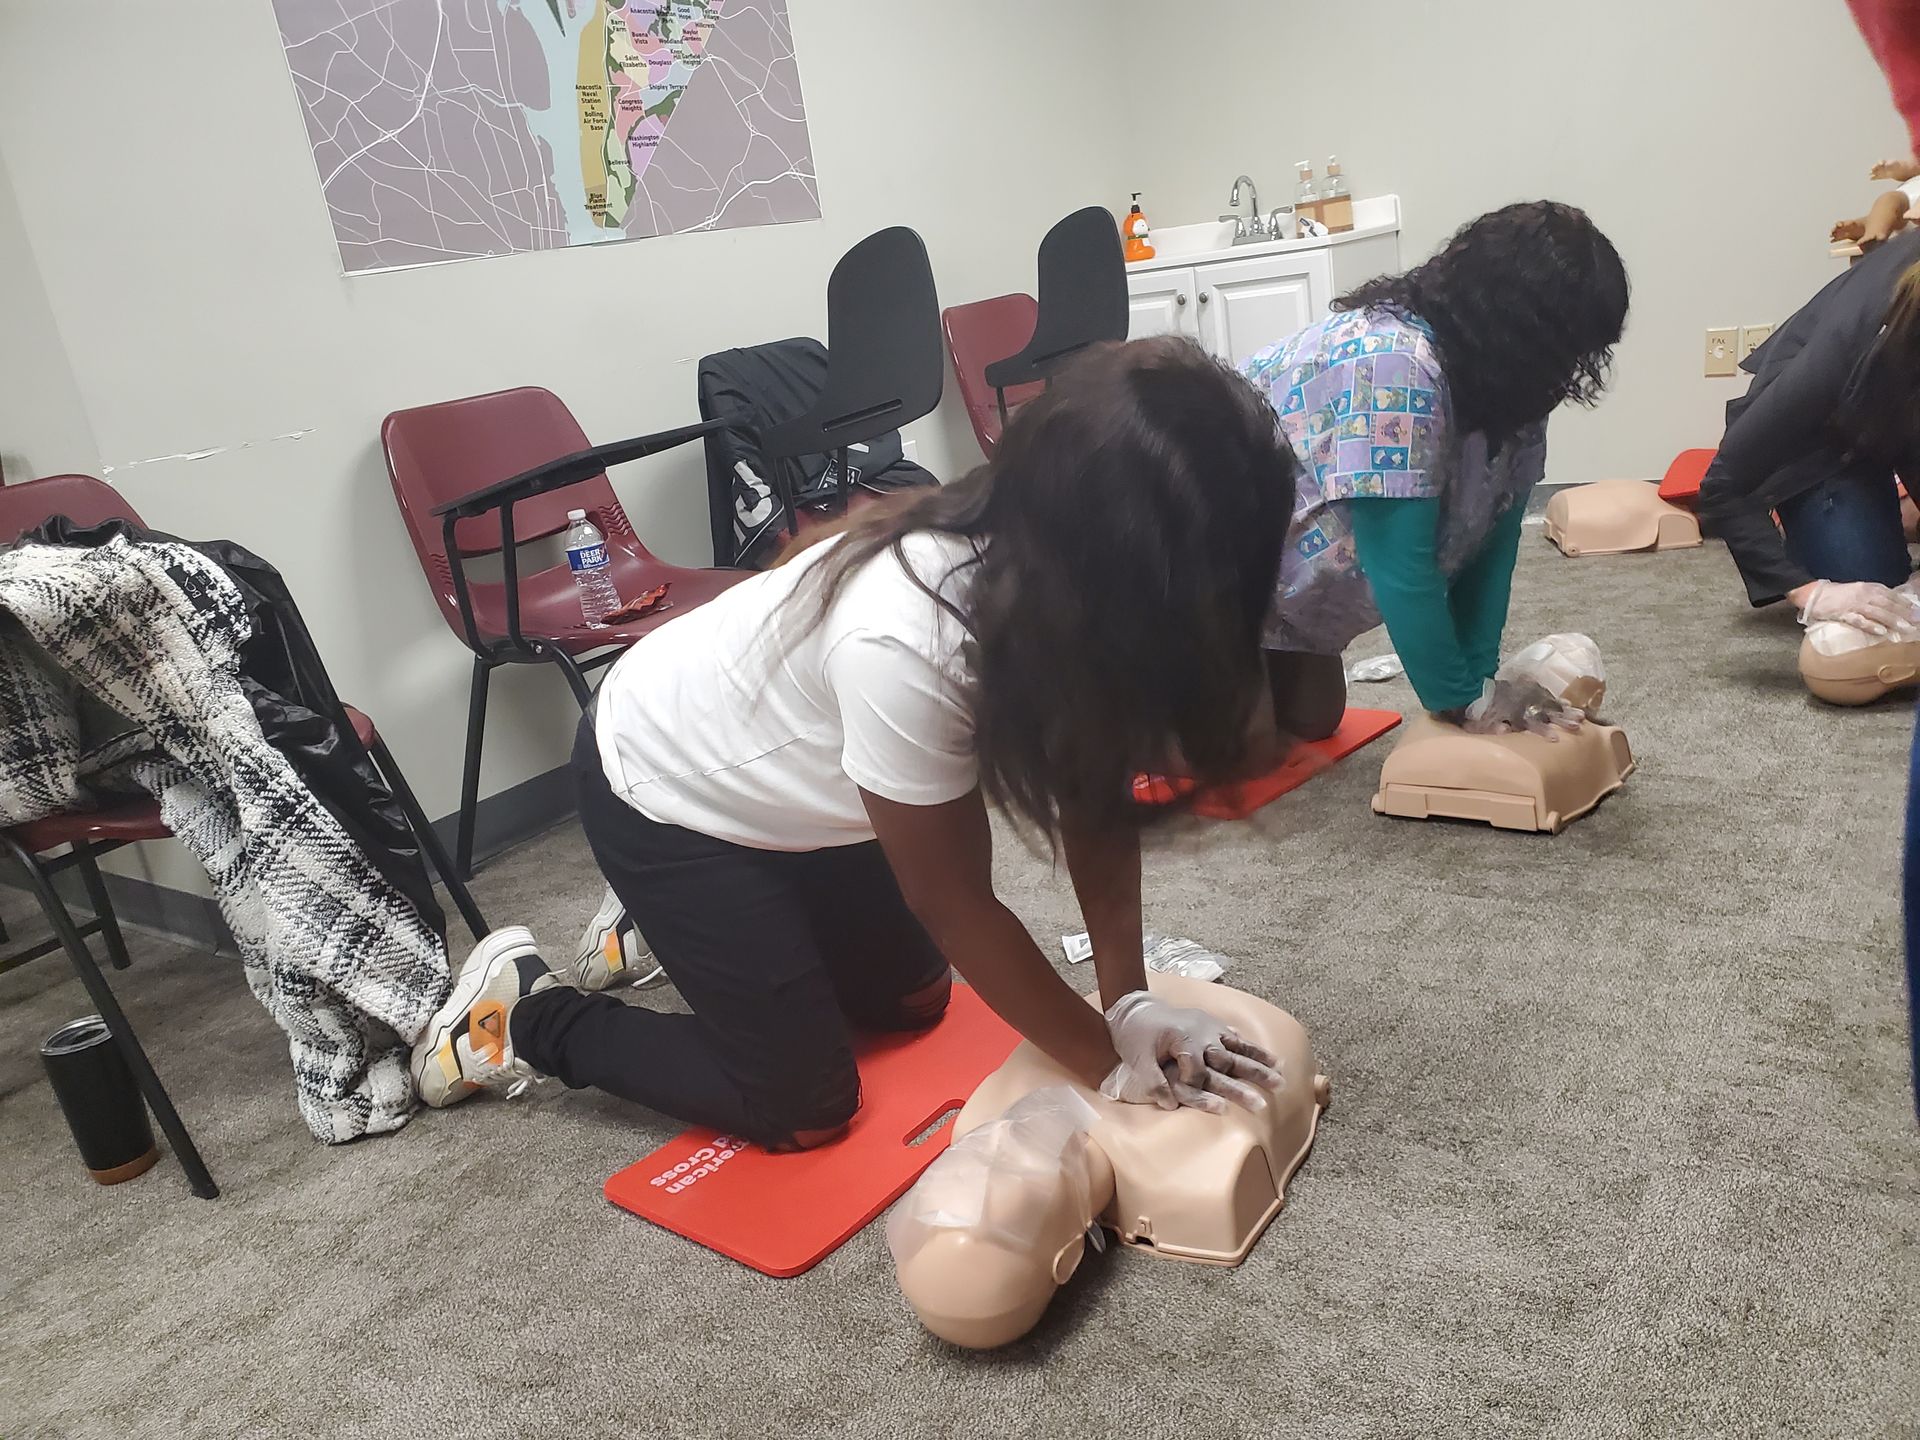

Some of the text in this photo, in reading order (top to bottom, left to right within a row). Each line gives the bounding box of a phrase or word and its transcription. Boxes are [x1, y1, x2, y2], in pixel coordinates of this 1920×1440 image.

[580, 548, 600, 559] DEER
[582, 556, 602, 565] PARK
[650, 1147, 716, 1187] Cross
